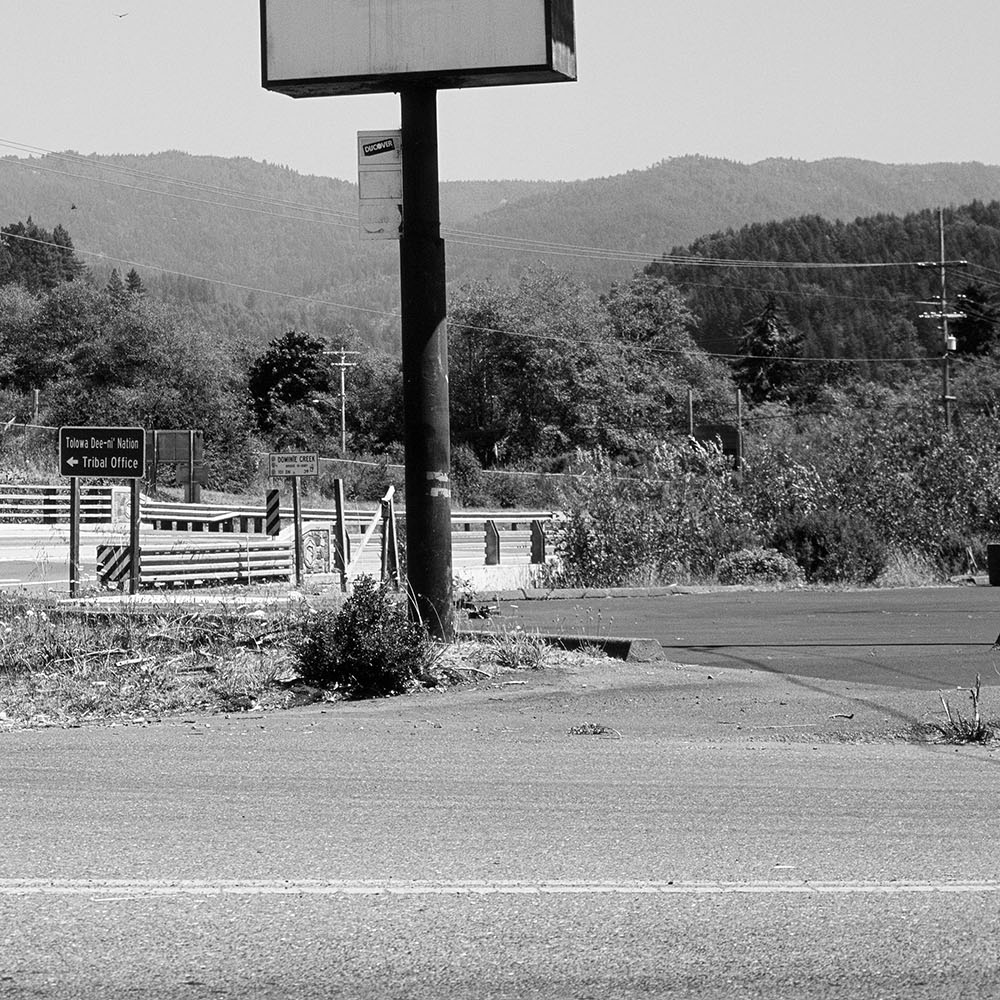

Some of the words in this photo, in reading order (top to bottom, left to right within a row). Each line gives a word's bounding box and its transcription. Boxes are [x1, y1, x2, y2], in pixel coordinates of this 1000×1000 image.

[65, 436, 89, 449] Tolowa
[117, 437, 139, 449] Nation
[82, 456, 108, 468] Tribal
[110, 456, 139, 469] Office
[299, 455, 316, 463] CREEK
